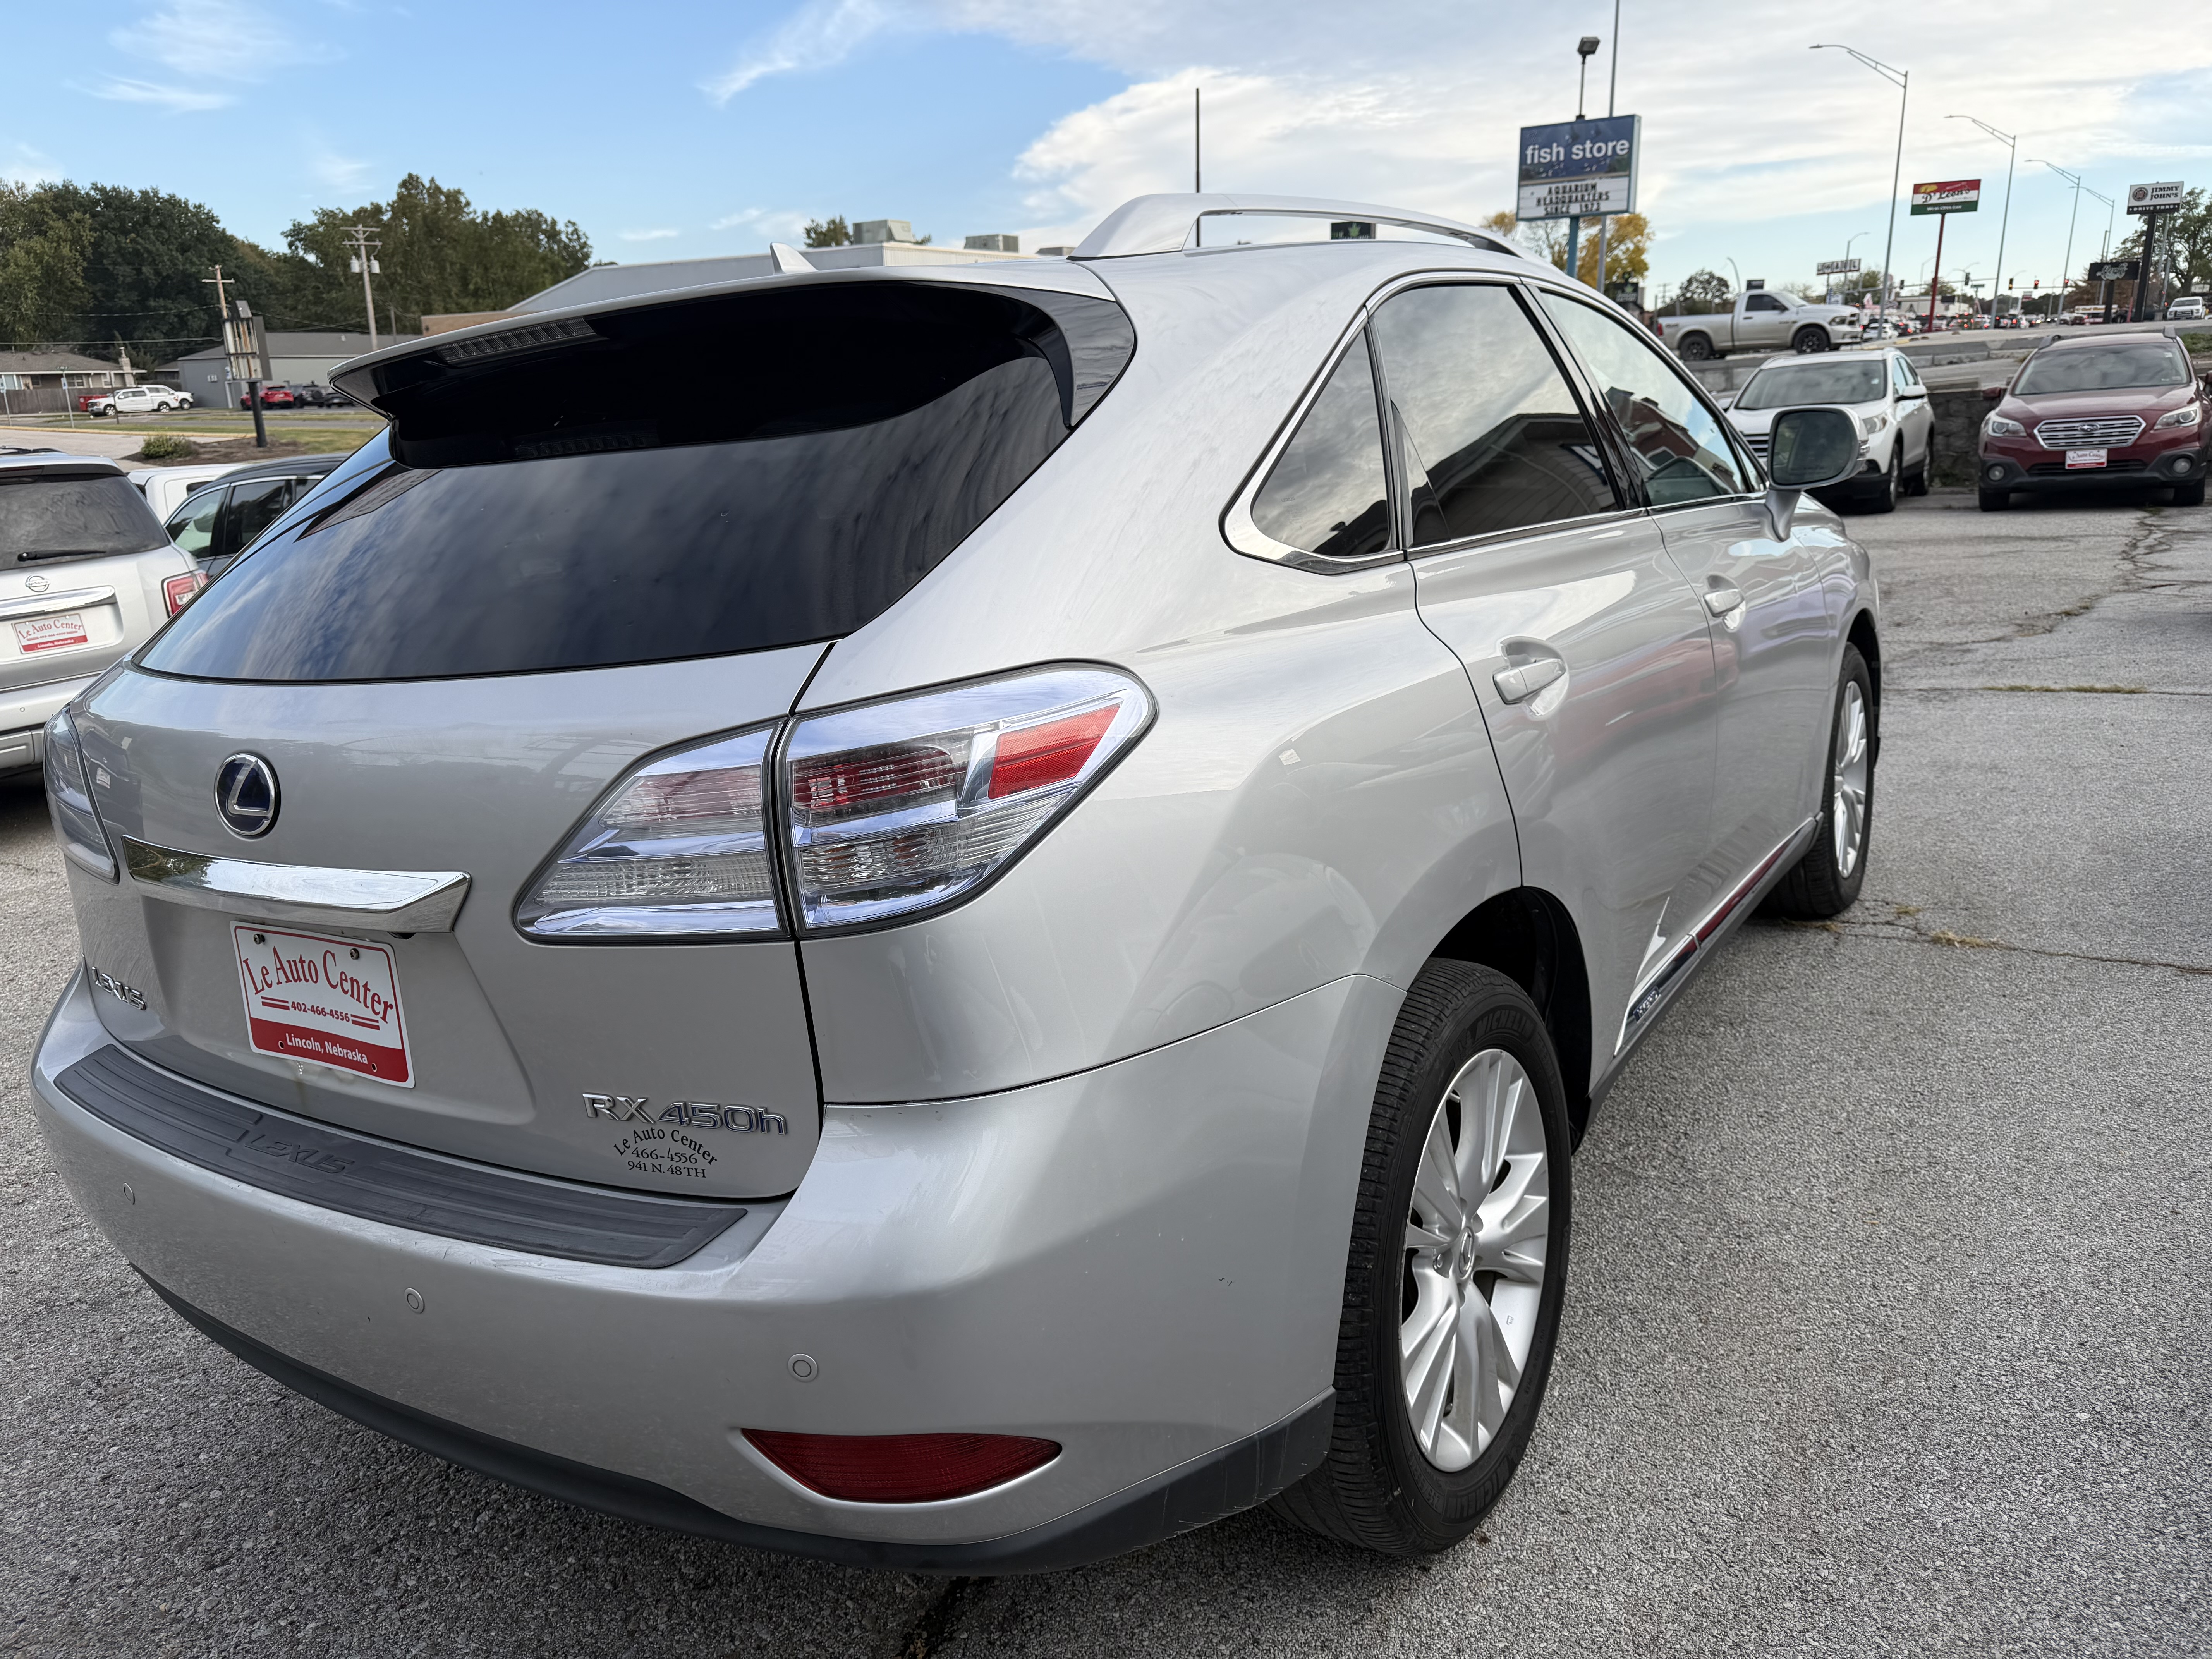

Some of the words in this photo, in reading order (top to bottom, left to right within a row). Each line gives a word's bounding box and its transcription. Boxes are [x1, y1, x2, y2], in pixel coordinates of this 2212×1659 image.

[1525, 143, 1565, 164] fish
[1571, 139, 1630, 160] store
[1536, 191, 1610, 206] HEADQUARTERS
[1547, 182, 1597, 196] AQUARIUM
[2150, 192, 2178, 201] JOHN'S
[1544, 204, 1571, 216] SINCE
[18, 629, 32, 639] Le
[31, 623, 52, 634] Auto
[53, 619, 82, 630] Center
[91, 966, 147, 1011] LEXUS
[243, 958, 273, 995] Le
[272, 945, 319, 985] Auto
[323, 950, 393, 1024] Center
[291, 1001, 350, 1023] 402-466-4556
[1475, 1009, 1534, 1040] MICHELIN
[285, 1033, 324, 1054] Lincoln,
[325, 1041, 368, 1065] Nebraska
[582, 1092, 656, 1124] RX
[657, 1101, 788, 1136] 450h
[244, 1134, 355, 1174] LEXUS
[613, 1138, 631, 1156] Le
[632, 1127, 666, 1144] Auto
[671, 1129, 718, 1166] Center
[631, 1146, 698, 1164] 466-4556
[627, 1160, 648, 1172] 941
[651, 1164, 665, 1175] N.
[667, 1165, 707, 1179] 48TH
[1446, 1457, 1510, 1519] MICHELIN
